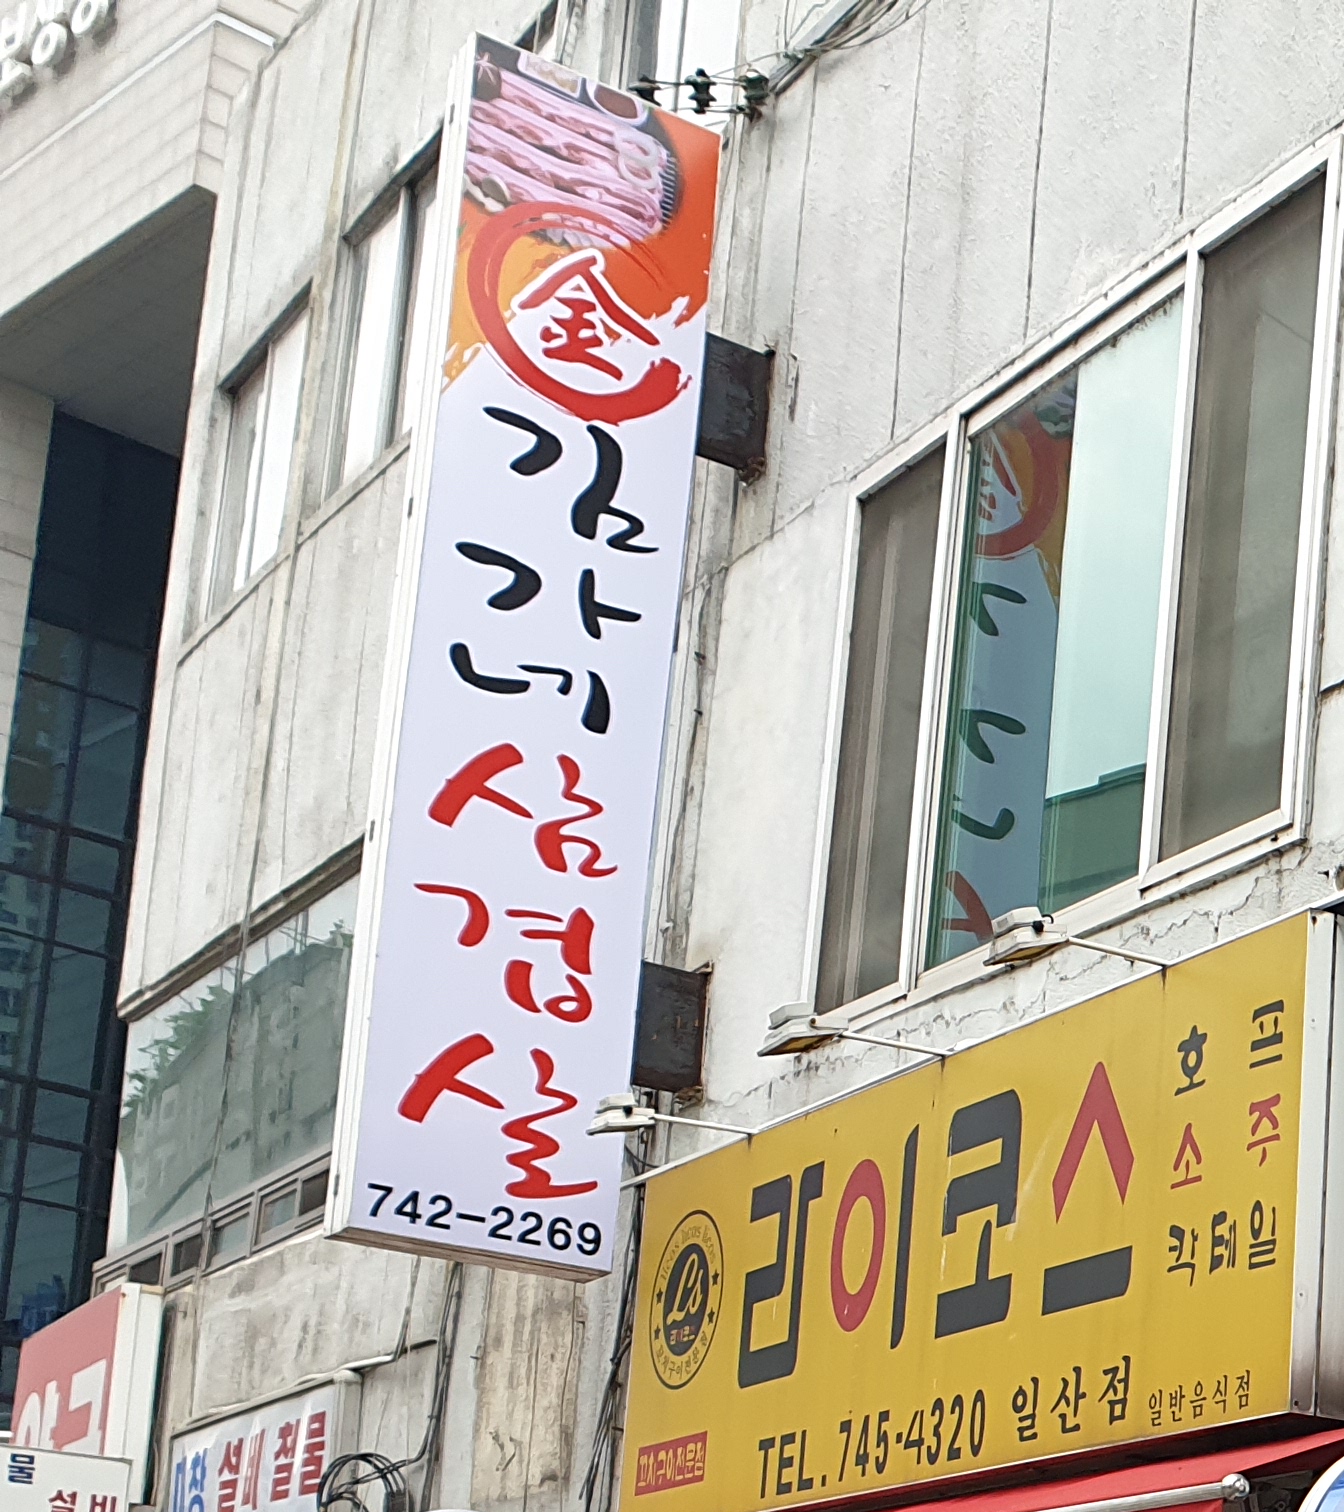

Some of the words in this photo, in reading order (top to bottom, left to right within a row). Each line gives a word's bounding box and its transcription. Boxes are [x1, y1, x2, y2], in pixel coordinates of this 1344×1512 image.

[518, 254, 660, 381] 金
[451, 406, 659, 734] 김가네
[398, 743, 617, 1199] 삼겹살
[1170, 1093, 1281, 1190] 소주
[367, 1183, 602, 1256] 742-2269
[738, 1062, 1134, 1387] 라이코스
[1166, 1199, 1277, 1287] 칵테일
[270, 1410, 326, 1502] 철물
[637, 1443, 705, 1488] 꼬치구이전문점
[759, 1434, 828, 1498] TEL.
[838, 1388, 986, 1483] 745-4320
[1011, 1355, 1131, 1440] 일산점
[1147, 1369, 1252, 1428] 일반음식점
